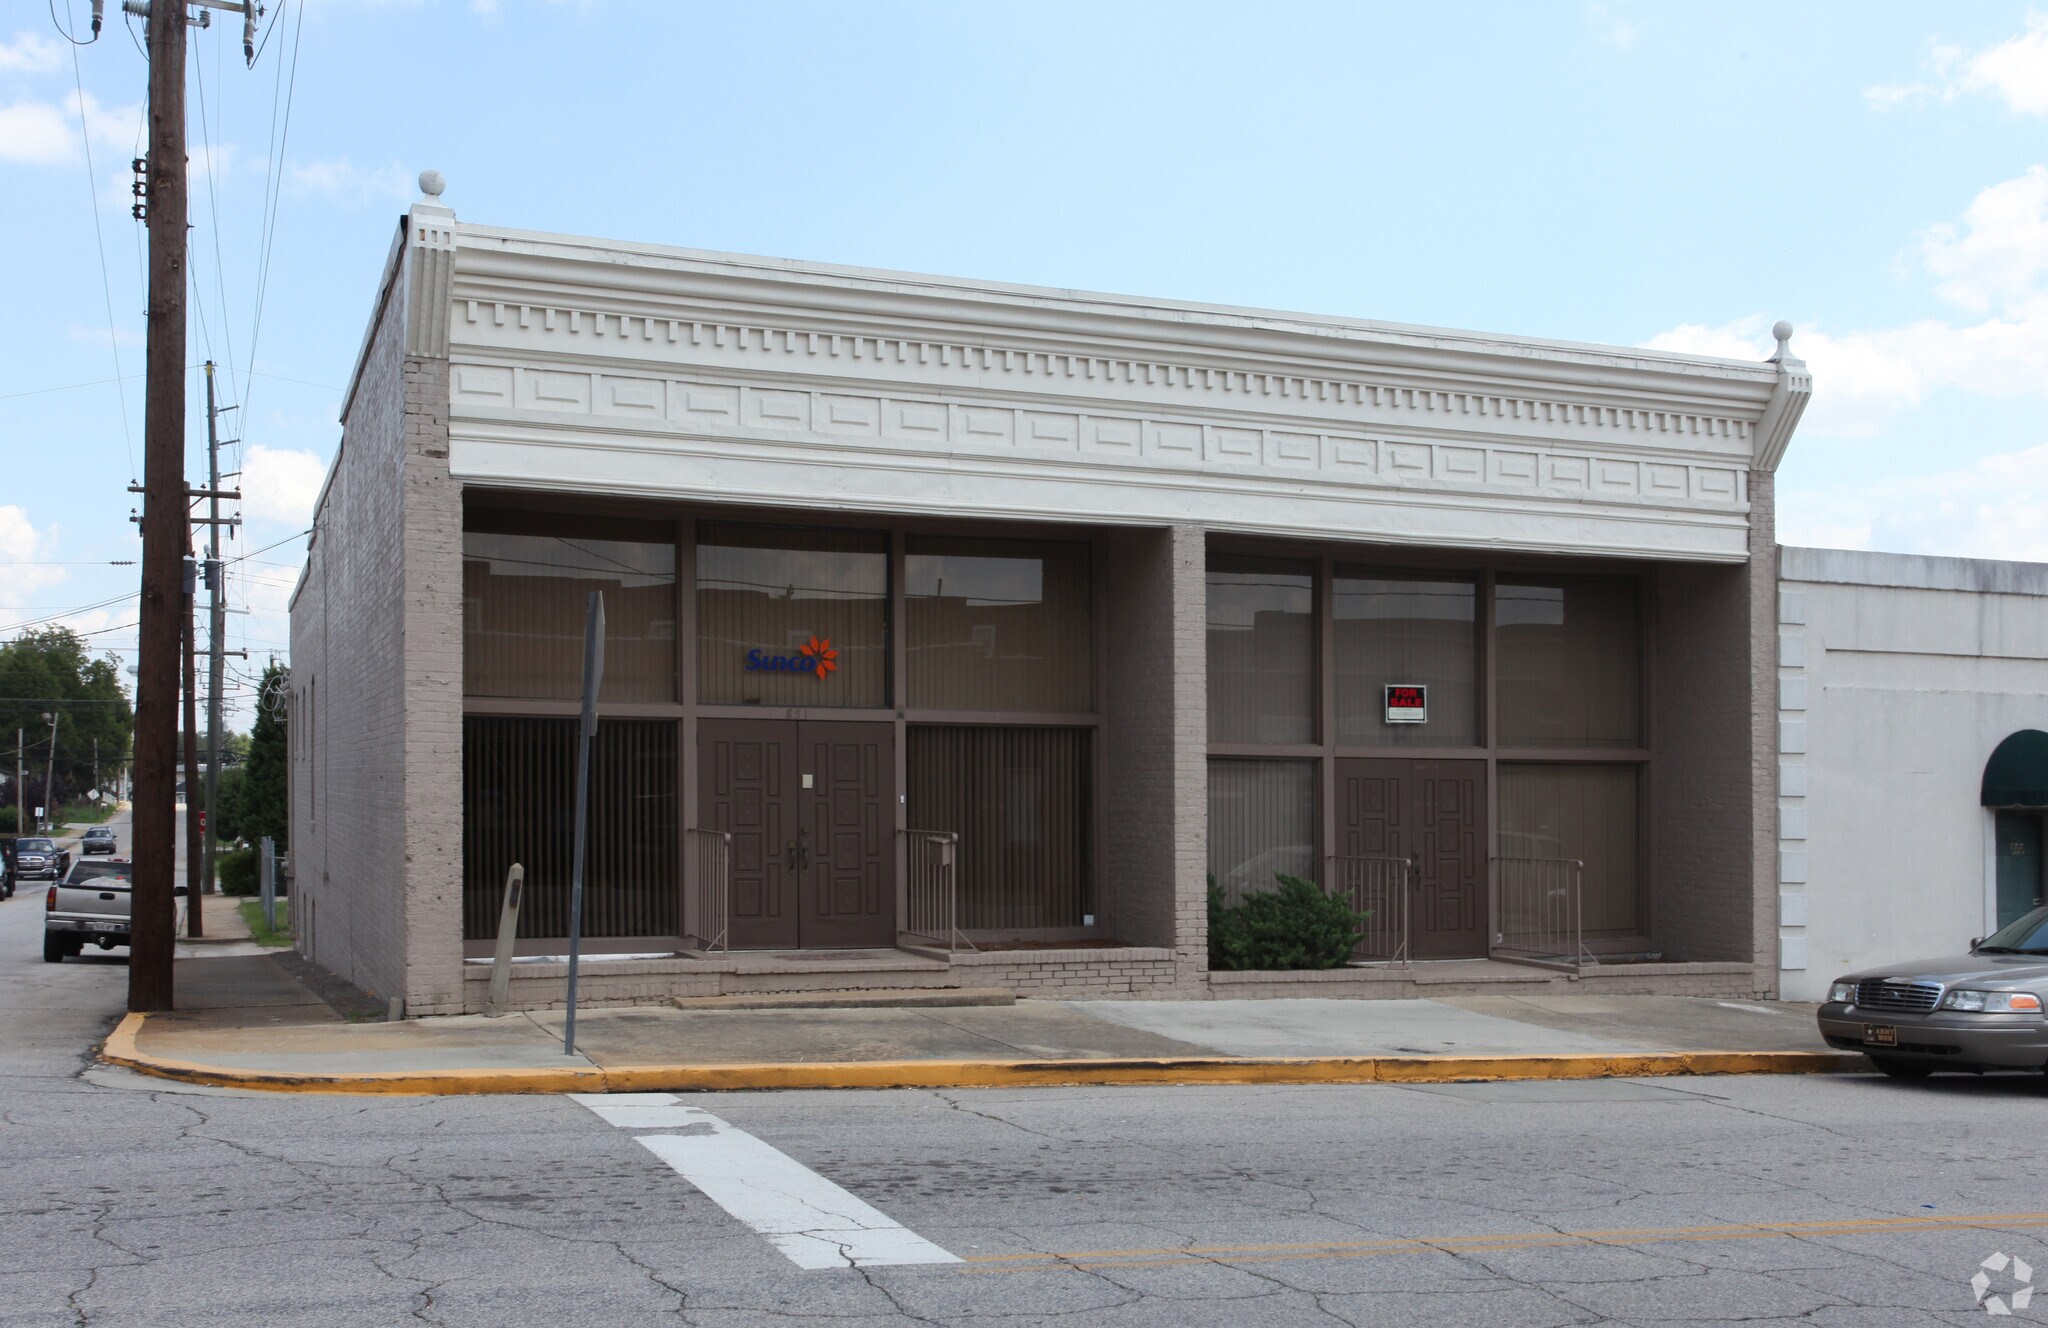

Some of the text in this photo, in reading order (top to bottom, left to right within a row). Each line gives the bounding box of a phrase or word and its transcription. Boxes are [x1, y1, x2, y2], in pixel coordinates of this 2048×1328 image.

[1395, 688, 1417, 697] FOR
[1391, 698, 1422, 706] SALE
[1875, 1028, 1895, 1036] ARMY
